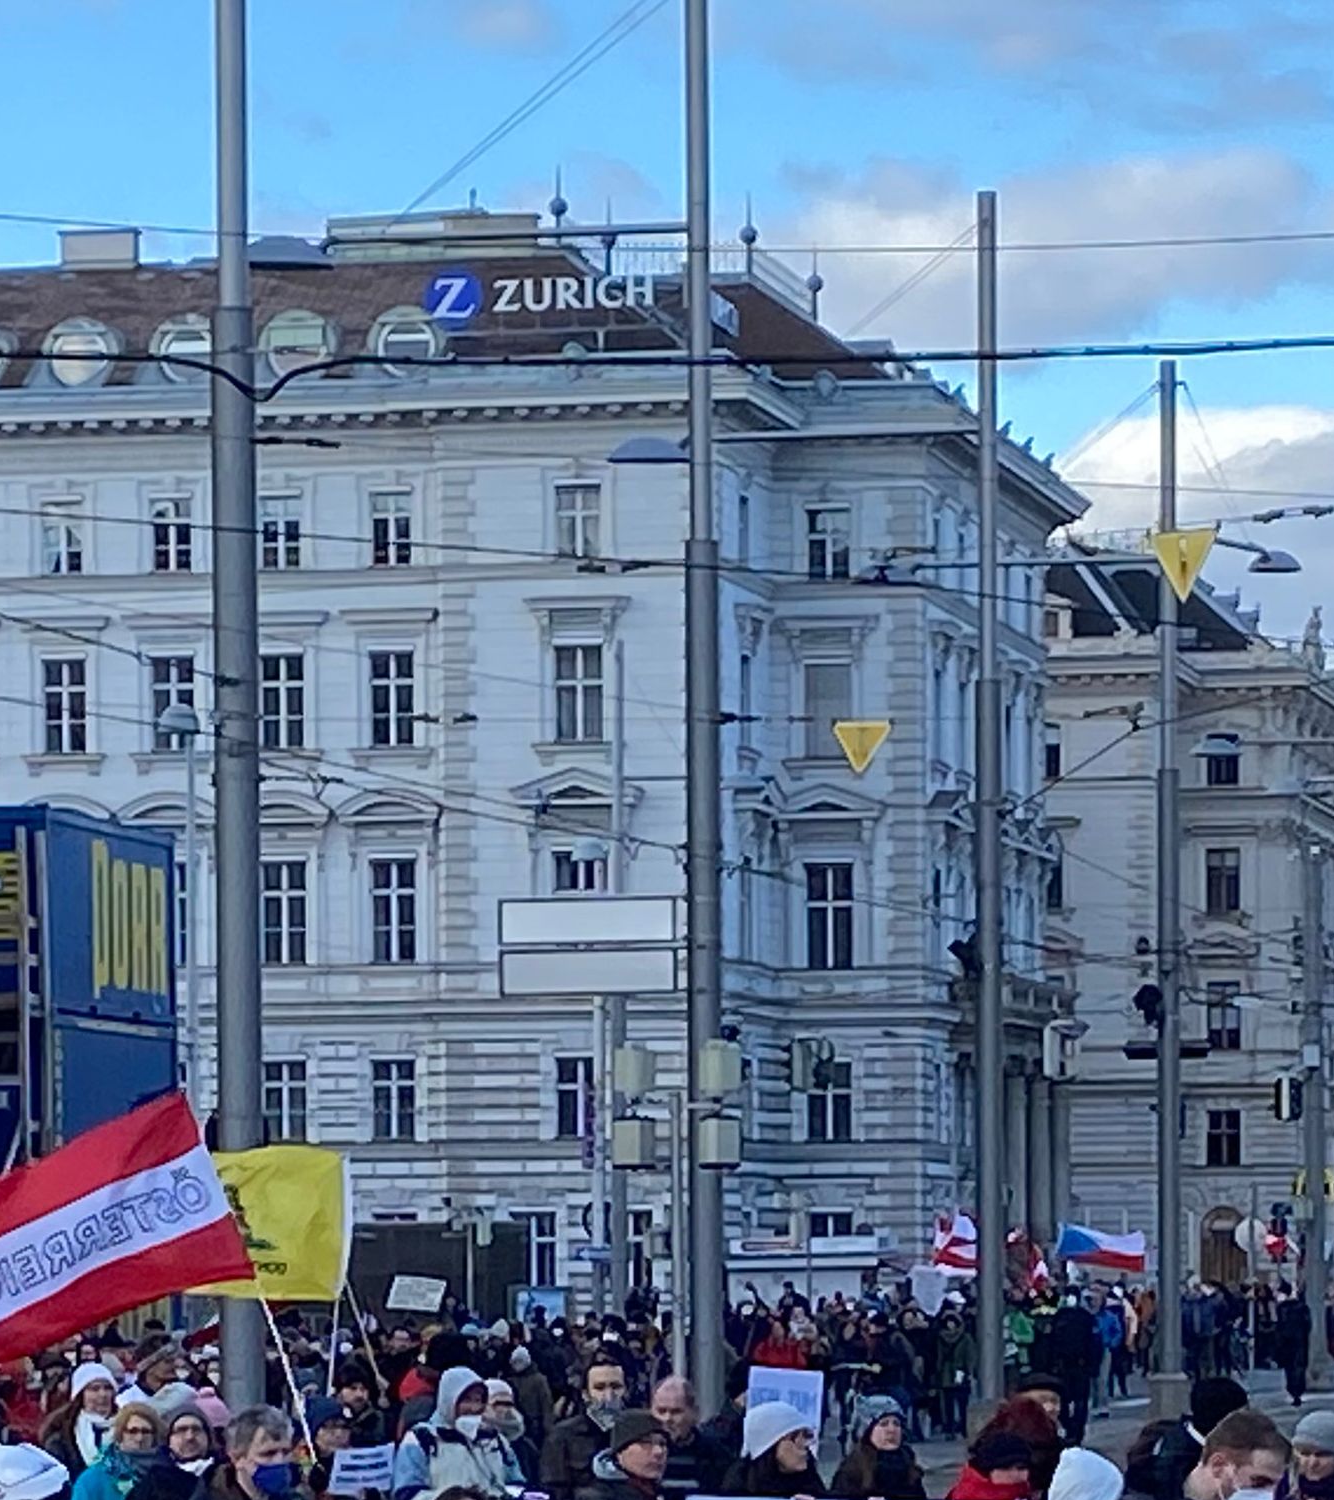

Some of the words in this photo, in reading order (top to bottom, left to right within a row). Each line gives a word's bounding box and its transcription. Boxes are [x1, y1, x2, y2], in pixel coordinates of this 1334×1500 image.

[432, 278, 475, 318] Z
[493, 276, 654, 312] ZURICH
[92, 839, 166, 999] PORR
